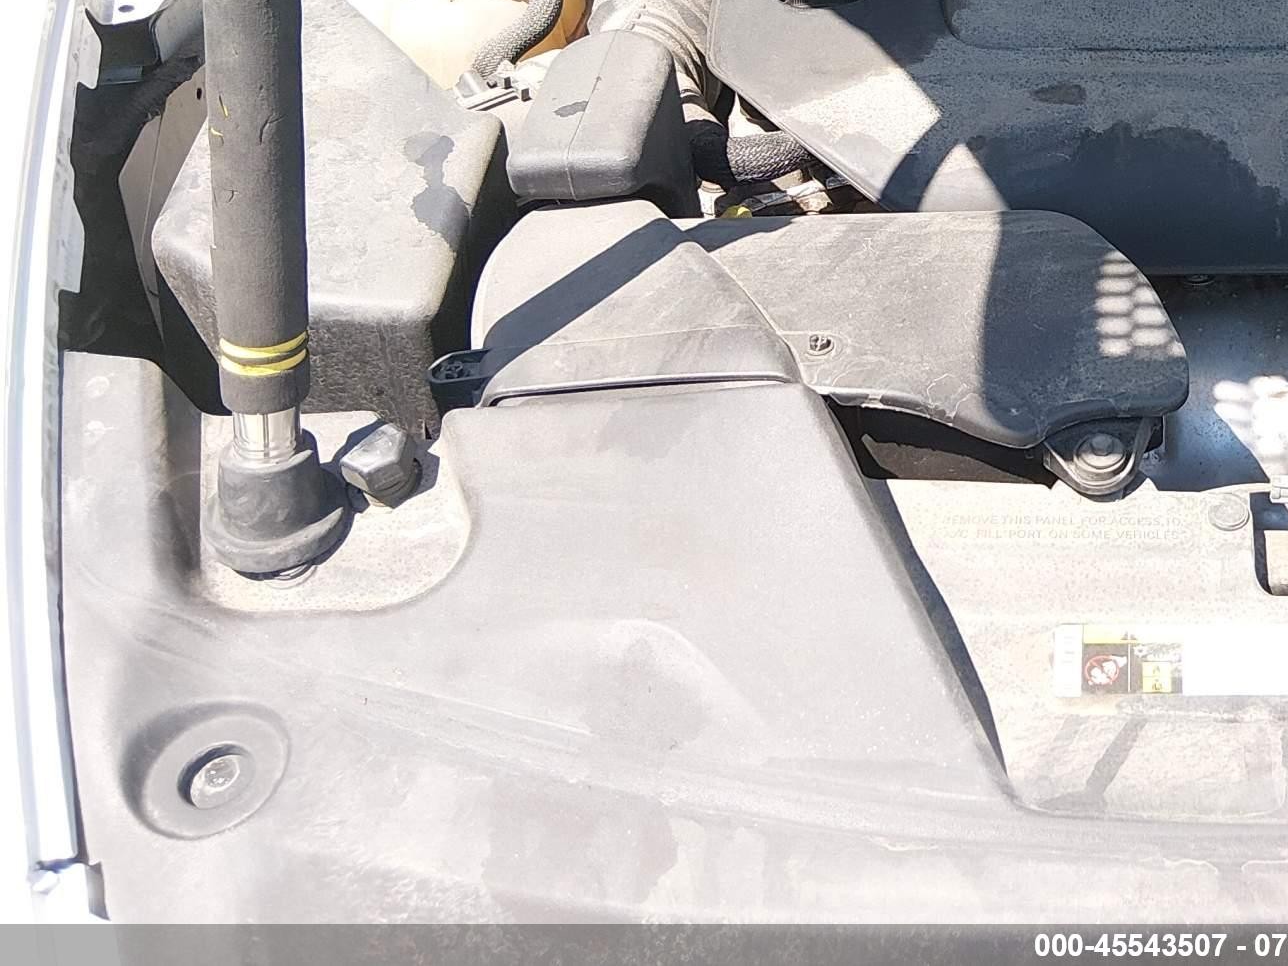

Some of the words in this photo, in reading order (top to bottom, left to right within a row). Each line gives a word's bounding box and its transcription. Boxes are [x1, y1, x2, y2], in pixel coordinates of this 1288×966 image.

[1001, 514, 1031, 525] THIS
[1034, 514, 1076, 525] PANEL
[1080, 516, 1106, 526] FOR
[1110, 516, 1160, 526] ACCESS
[976, 529, 1002, 538] FILL
[1008, 529, 1041, 538] PORT
[1048, 529, 1067, 538] ON
[1072, 529, 1111, 539] SOME
[1117, 529, 1179, 539] VEHICLES
